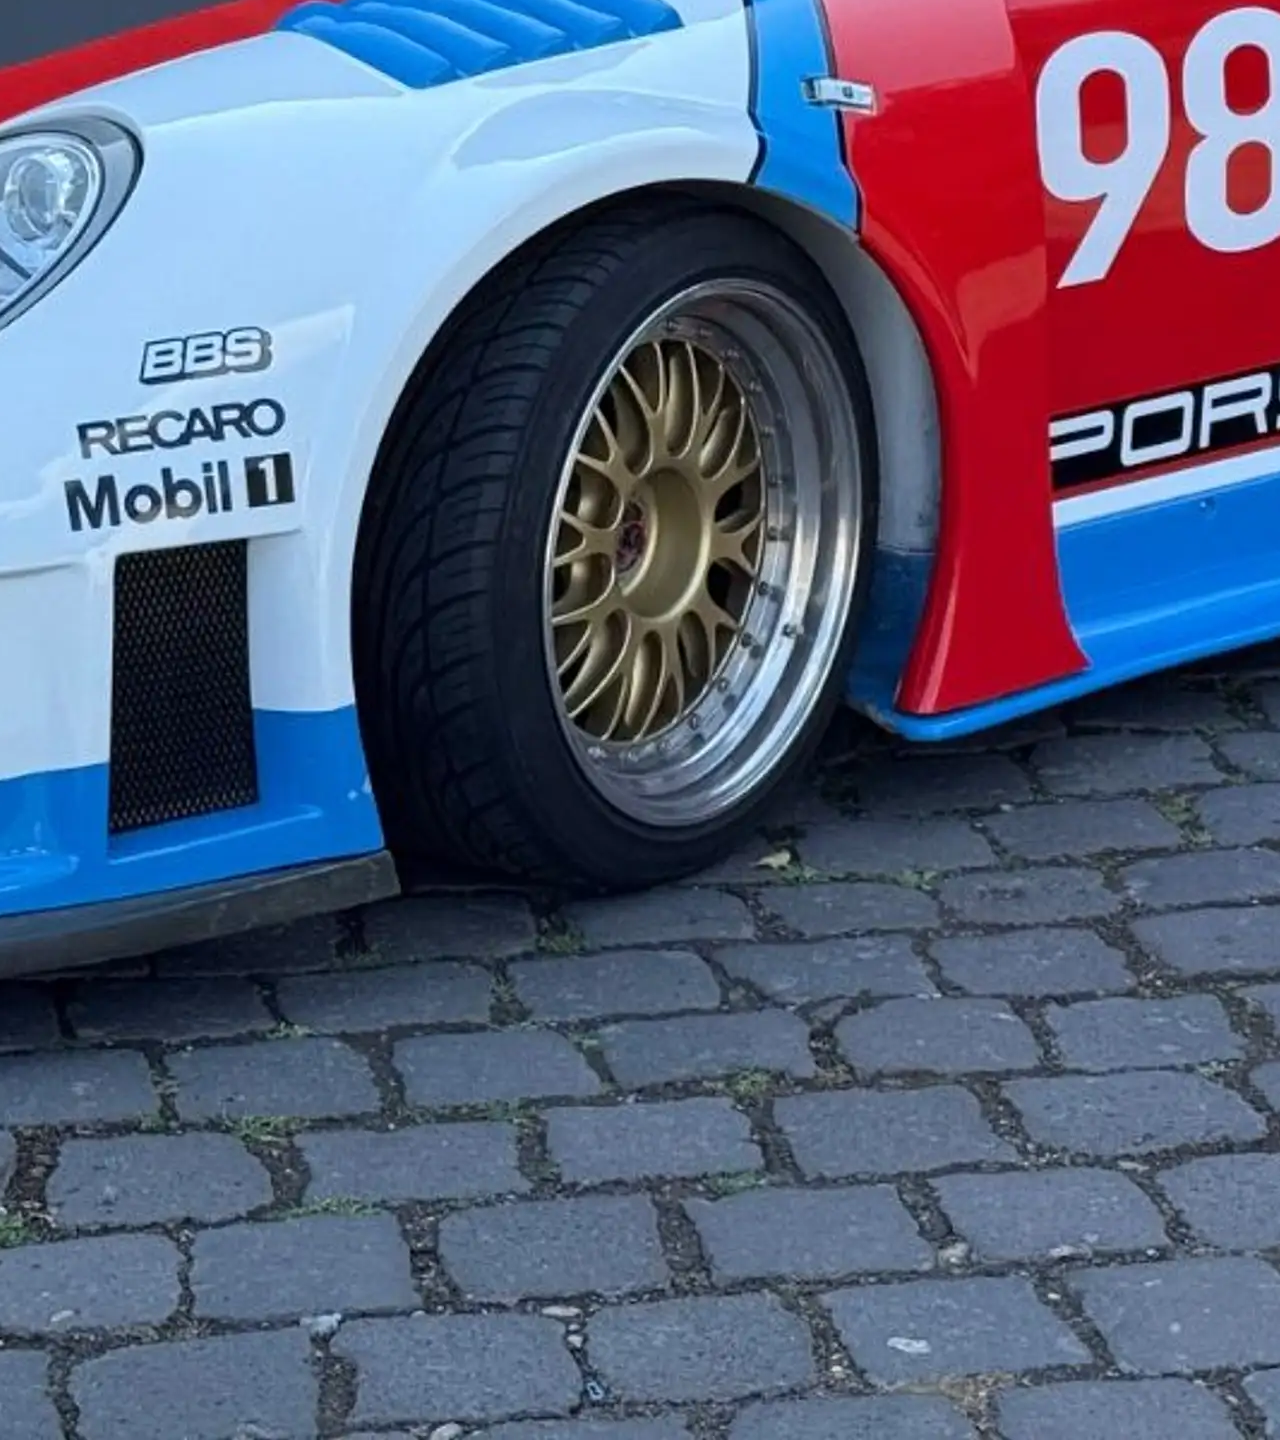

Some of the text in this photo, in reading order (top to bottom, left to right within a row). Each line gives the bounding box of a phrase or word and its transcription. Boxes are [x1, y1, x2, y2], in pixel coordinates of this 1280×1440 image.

[139, 326, 273, 385] BBS
[76, 398, 286, 459] RECARO
[64, 460, 233, 532] Mobil
